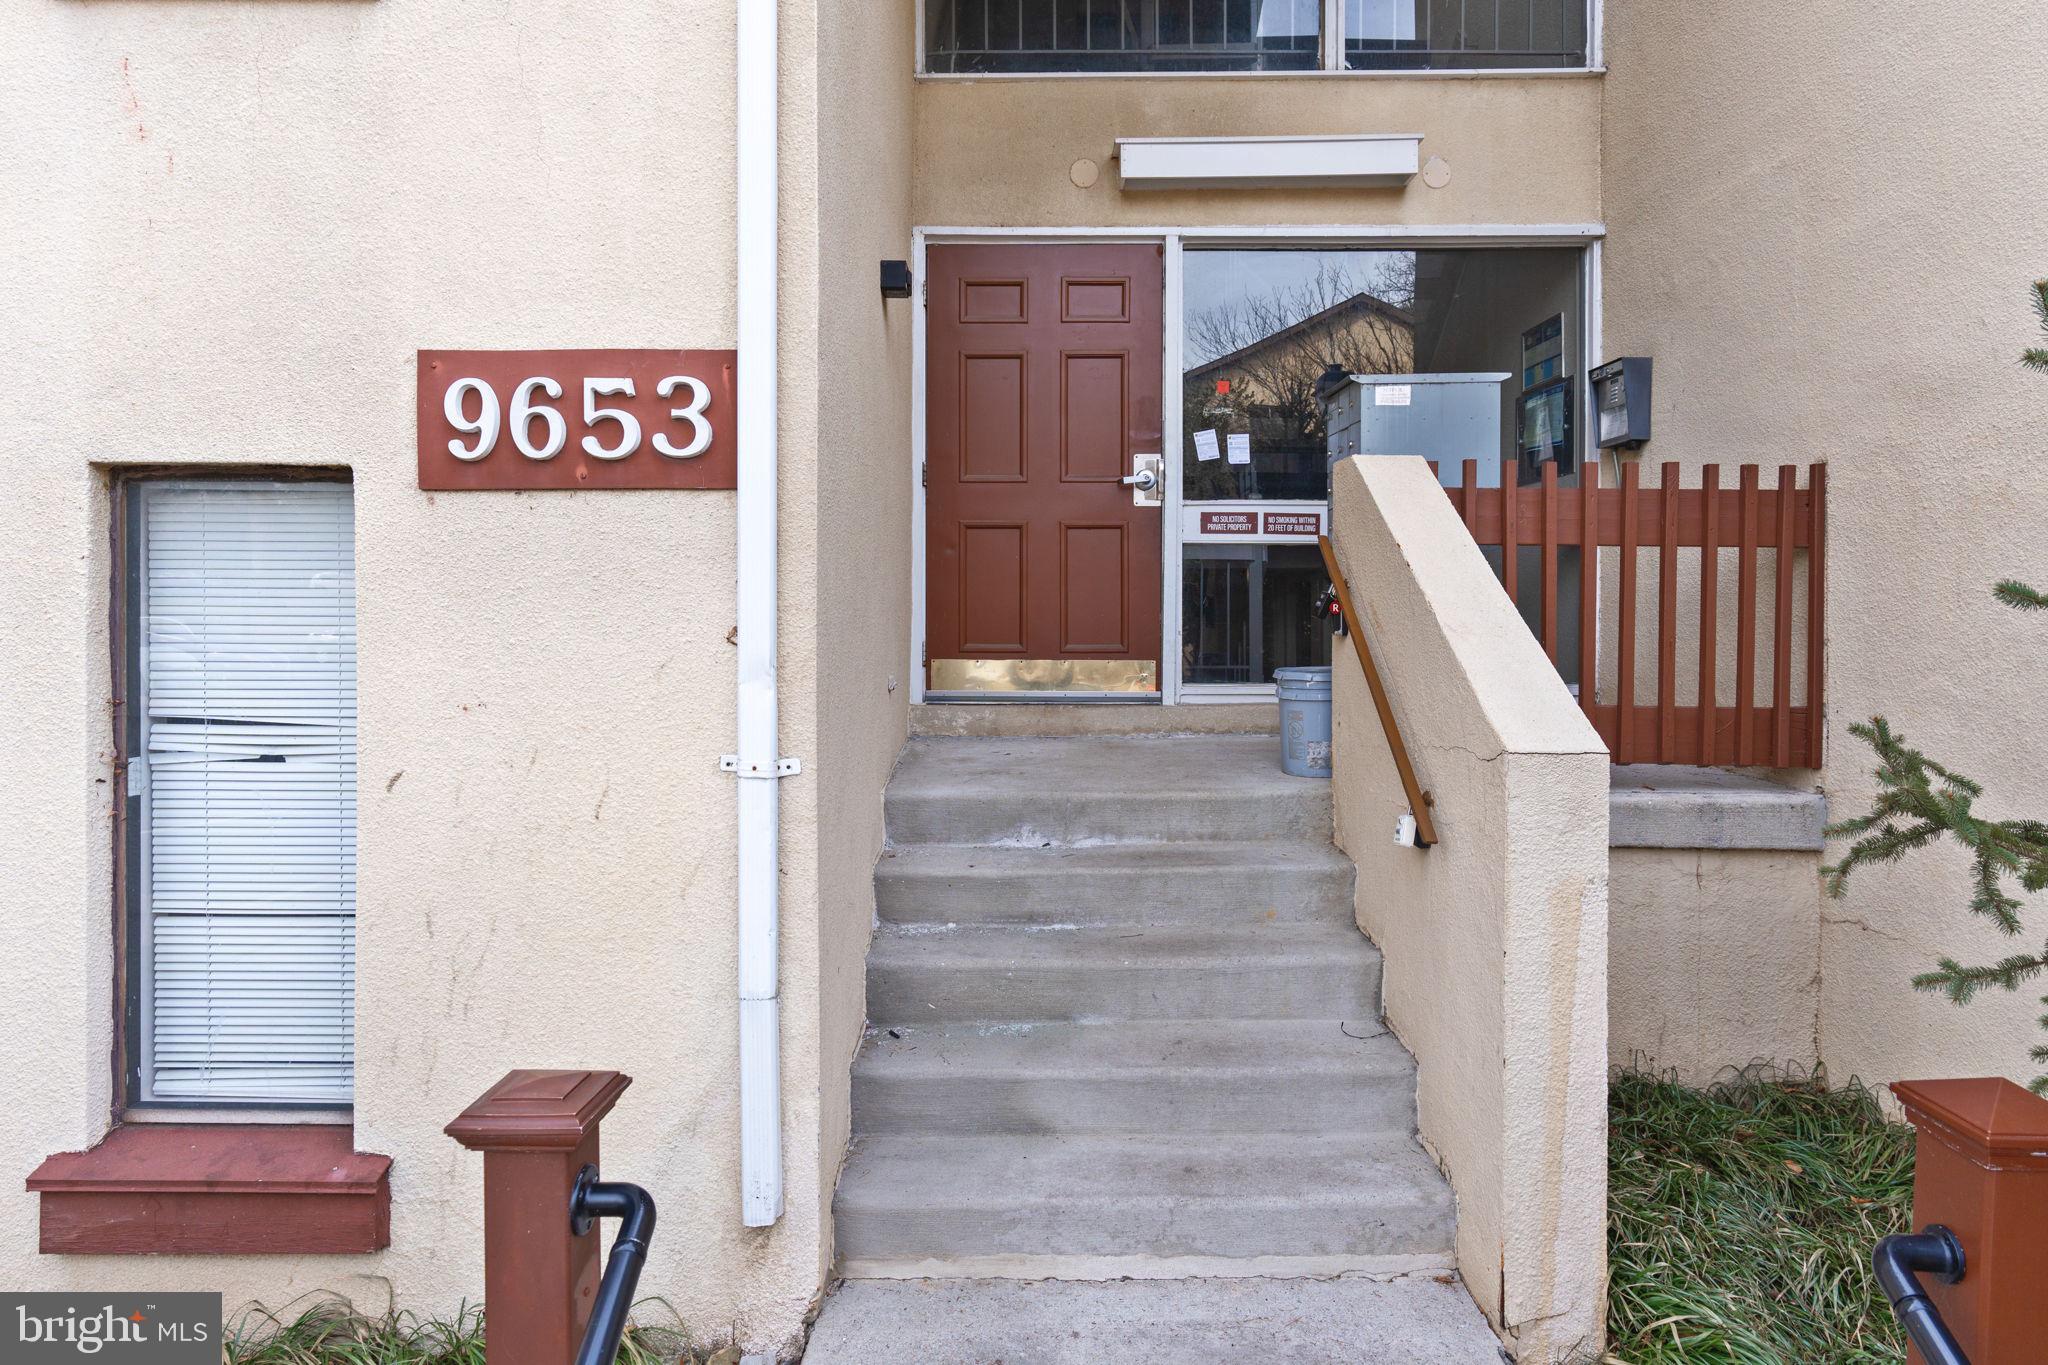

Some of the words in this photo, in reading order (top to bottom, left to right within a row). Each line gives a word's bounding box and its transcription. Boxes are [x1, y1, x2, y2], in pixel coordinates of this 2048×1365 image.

[443, 376, 713, 462] 9653
[1212, 515, 1219, 523] NO
[1220, 515, 1247, 523] SOLICITORS
[1276, 516, 1298, 524] SMOKING
[1207, 523, 1227, 531] PRIVATE
[1228, 523, 1252, 531] PROPERTY
[1267, 524, 1275, 532] 20
[1275, 524, 1287, 532] FEET
[1294, 524, 1316, 532] BUILDING
[1332, 603, 1339, 612] R
